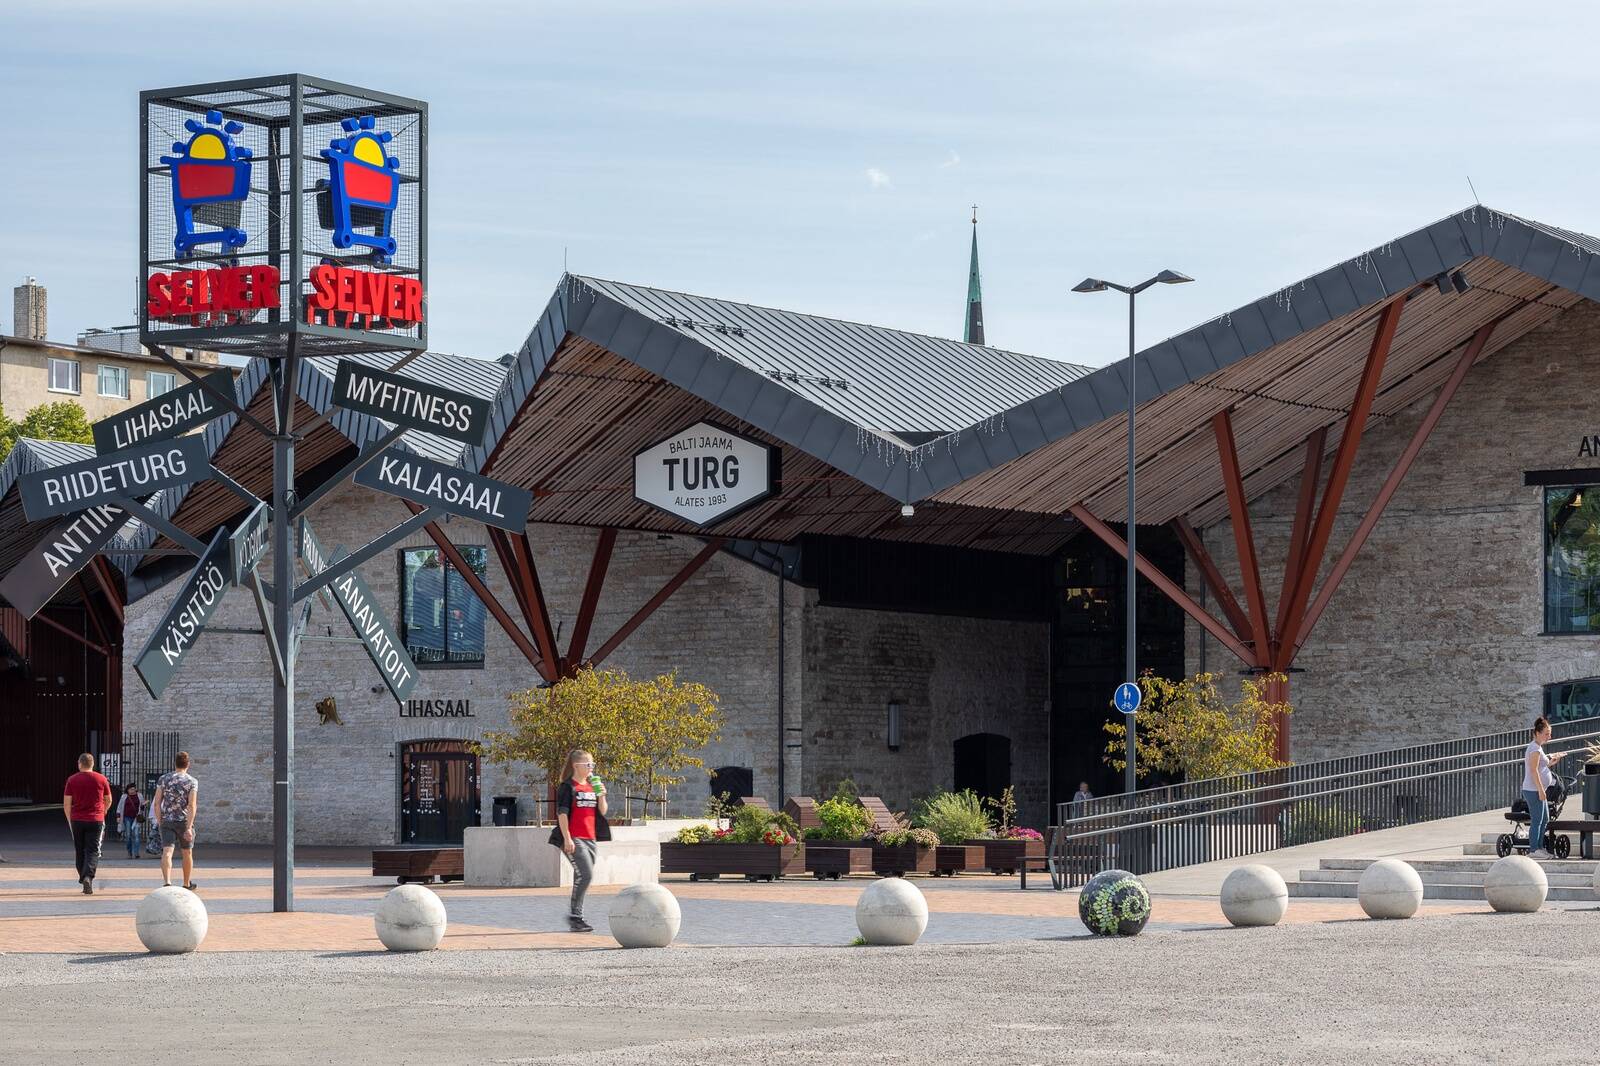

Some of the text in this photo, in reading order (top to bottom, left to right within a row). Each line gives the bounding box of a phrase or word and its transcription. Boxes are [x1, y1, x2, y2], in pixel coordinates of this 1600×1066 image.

[147, 265, 280, 316] SELVER
[310, 264, 422, 322] SELVER
[113, 388, 213, 449] LIHASAAL
[346, 373, 472, 432] MYFITNESS
[662, 455, 739, 491] TURG
[669, 437, 733, 454] BALTI JAAMA
[43, 449, 187, 506] RIIDETURG
[378, 456, 505, 518] KALASAAL
[674, 493, 727, 507] ALATES 1993
[42, 503, 124, 578] ANTIIK
[159, 560, 225, 666] KÄSITÖÖ
[335, 570, 411, 689] ÄNAVATOIT
[400, 699, 475, 717] LIHASAAL
